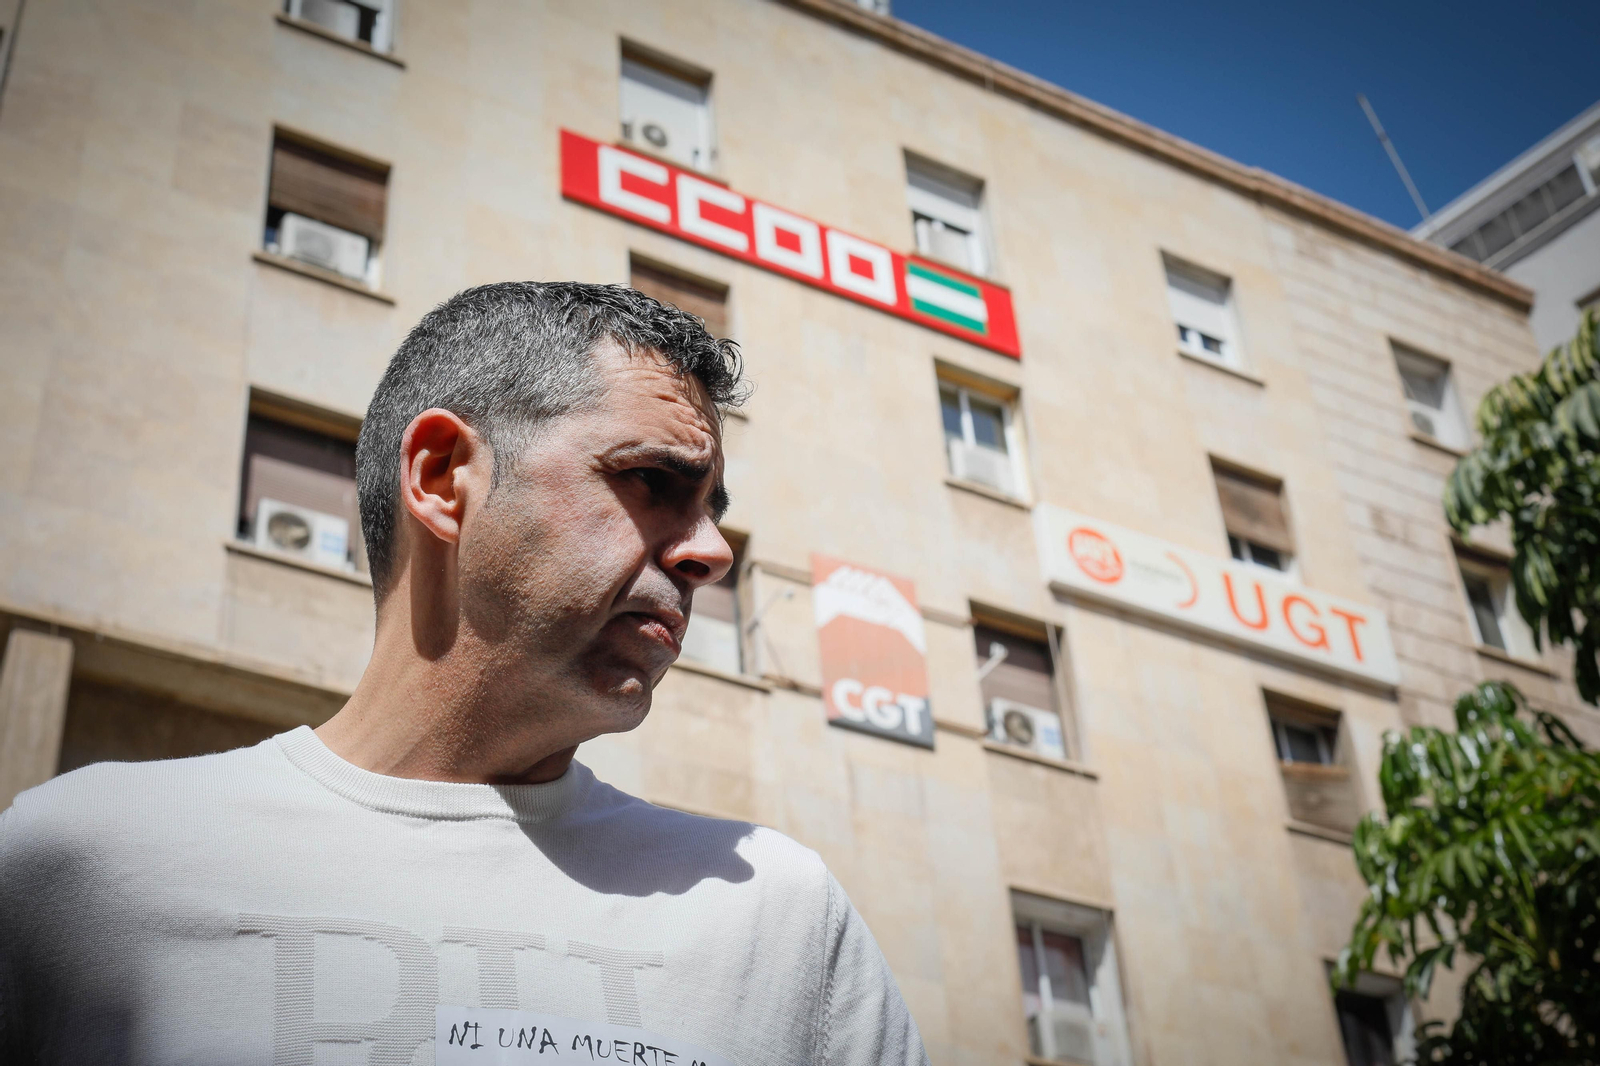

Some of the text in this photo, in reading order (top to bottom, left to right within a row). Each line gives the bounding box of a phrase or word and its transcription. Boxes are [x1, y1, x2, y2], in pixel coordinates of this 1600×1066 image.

[598, 145, 897, 306] CCOO
[1222, 570, 1366, 662] UGT
[832, 677, 926, 735] CGT
[449, 1021, 680, 1066] NI UNA MUERTE
